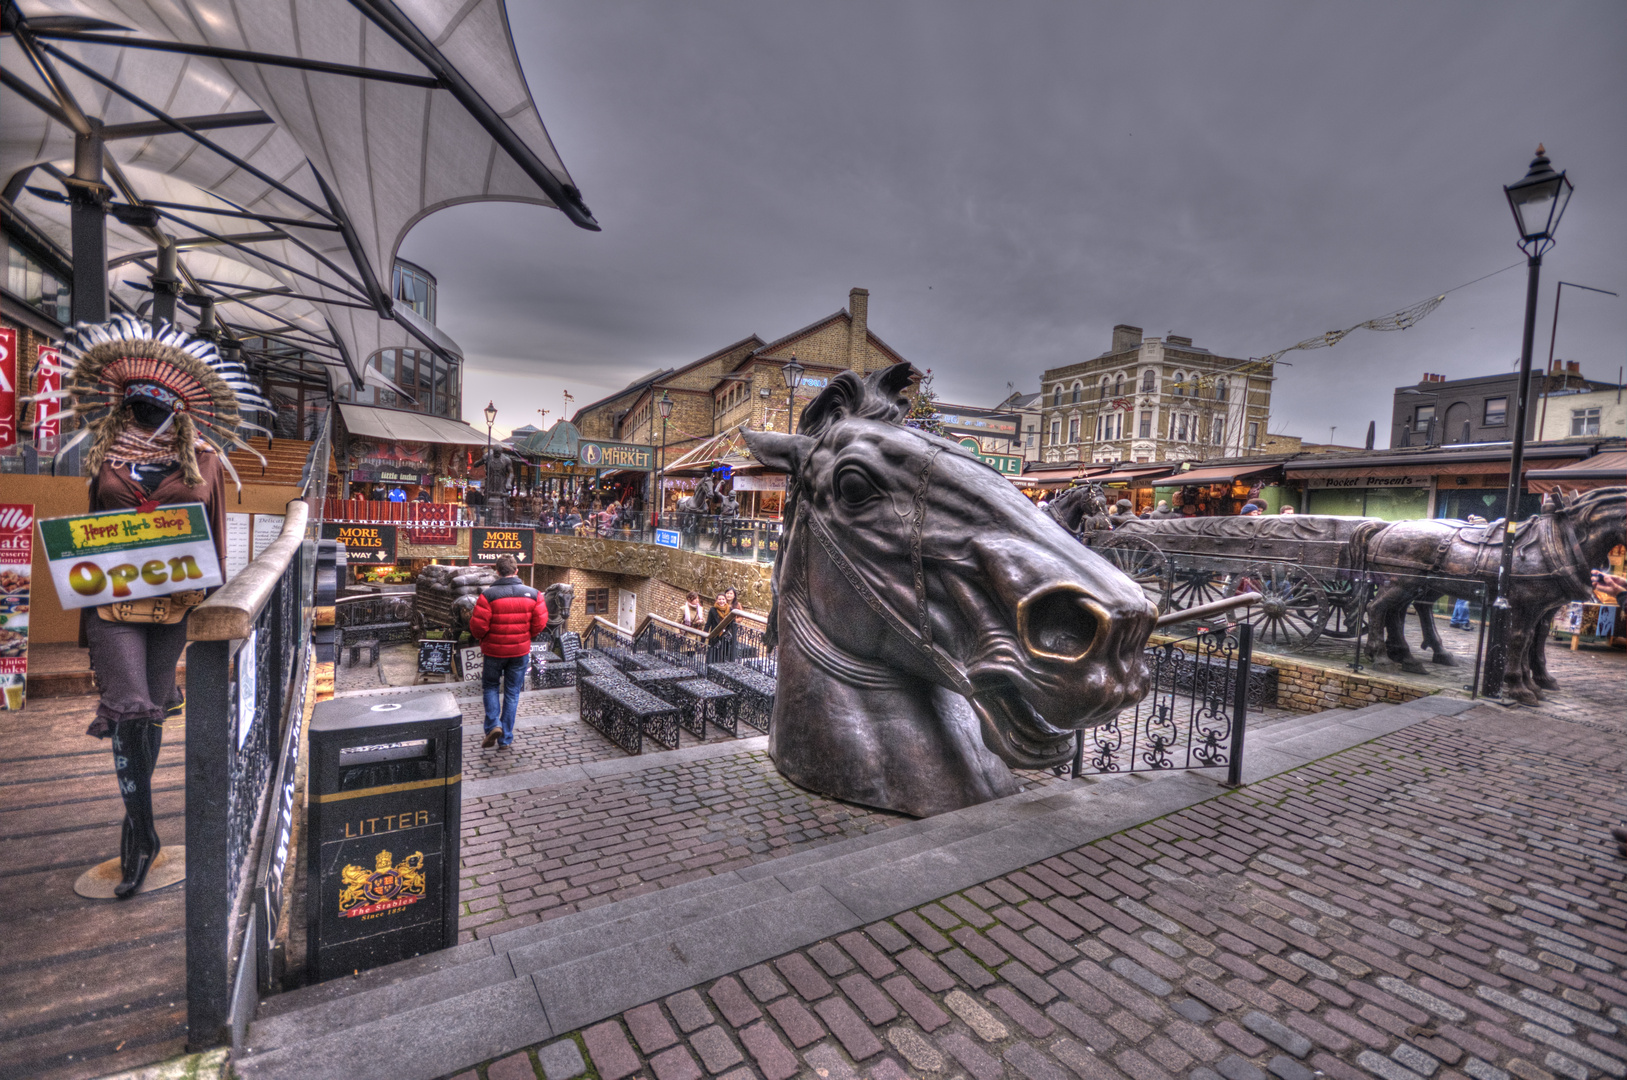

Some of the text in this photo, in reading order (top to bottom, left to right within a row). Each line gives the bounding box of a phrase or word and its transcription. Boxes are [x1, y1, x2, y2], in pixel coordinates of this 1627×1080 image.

[39, 353, 57, 452] SALE
[601, 447, 649, 467] MARKET
[381, 471, 417, 481] little india
[1326, 475, 1413, 487] Pocket Presents
[81, 516, 184, 541] Happy Herb Shop
[406, 520, 446, 529] SINCE
[450, 520, 474, 528] 1854
[339, 527, 378, 538] MORE
[486, 531, 519, 541] MORE
[336, 537, 382, 547] STALLS
[482, 540, 522, 549] STALLS
[68, 554, 204, 598] Open
[6, 659, 26, 667] juice
[345, 810, 429, 838] LITTER
[351, 897, 414, 917] The Stables
[361, 906, 406, 921] Since 1854
